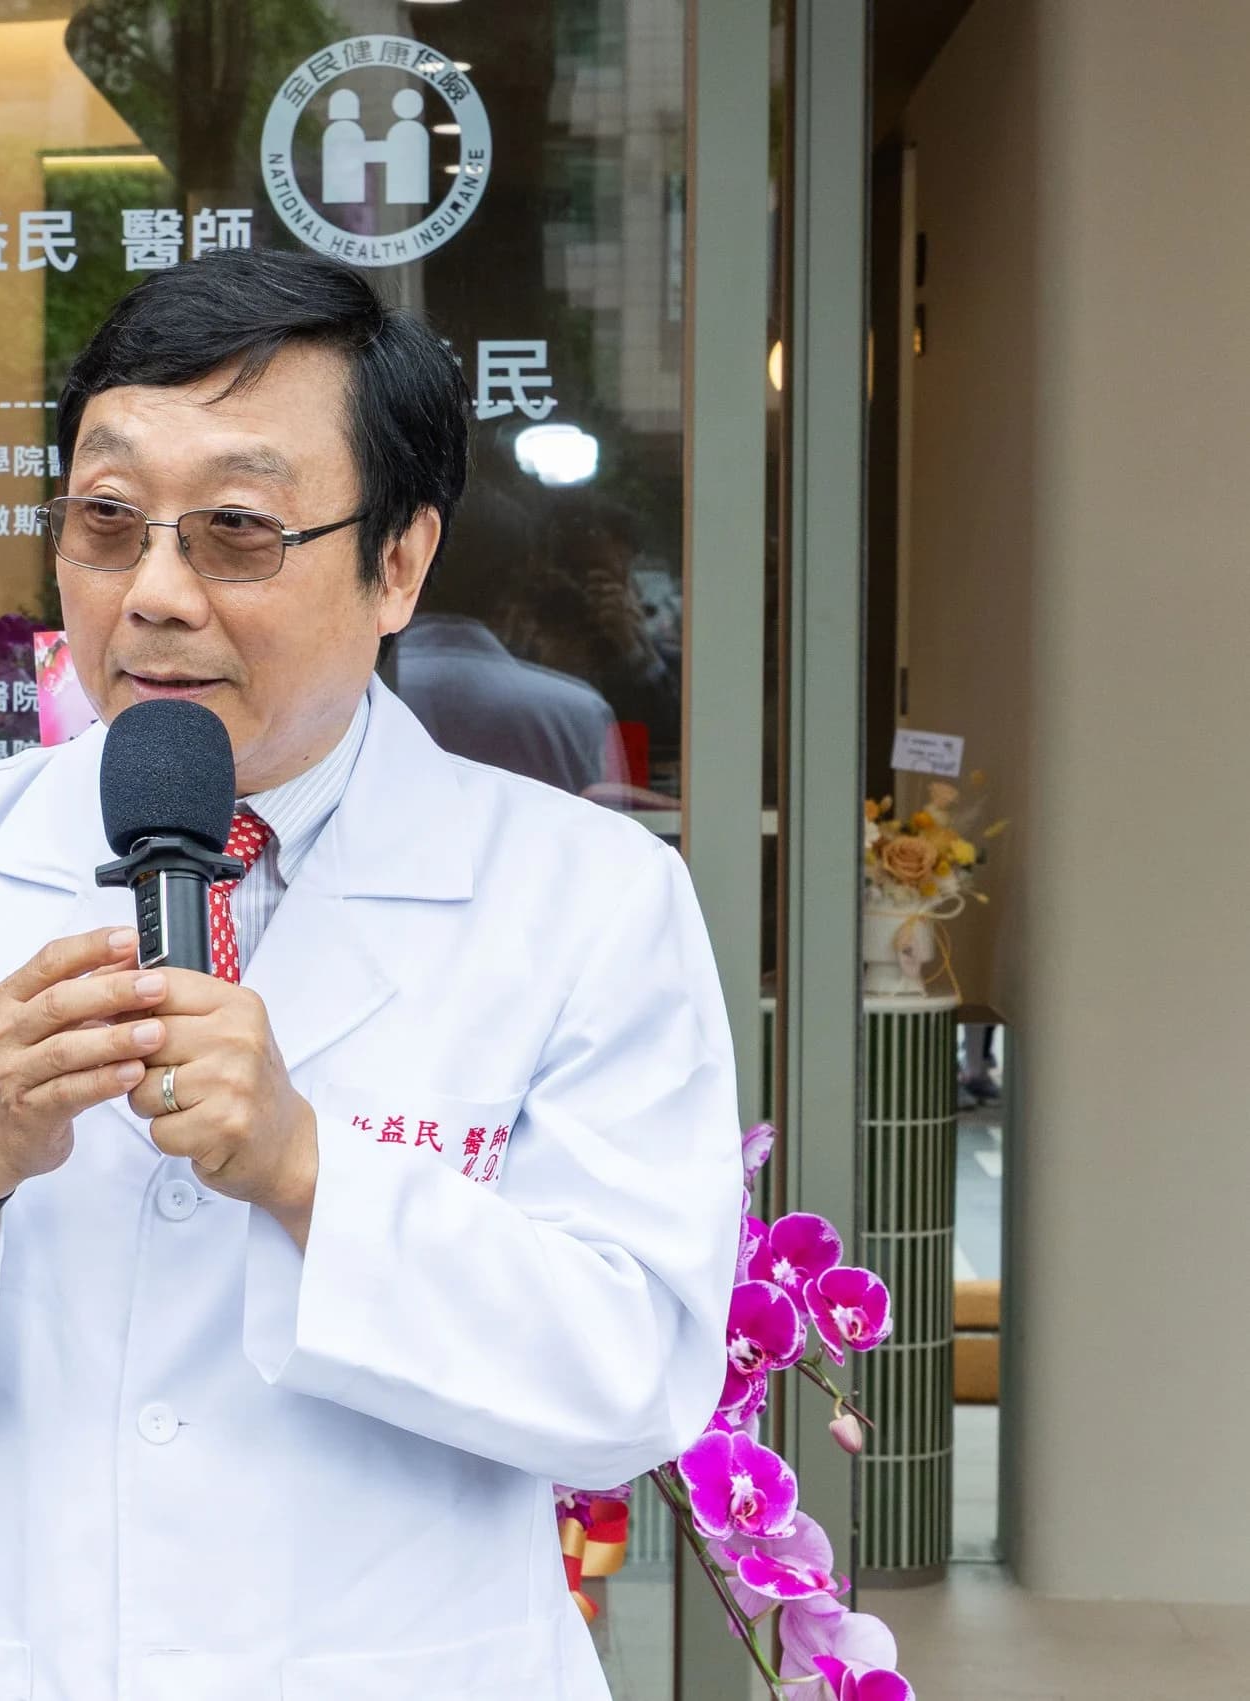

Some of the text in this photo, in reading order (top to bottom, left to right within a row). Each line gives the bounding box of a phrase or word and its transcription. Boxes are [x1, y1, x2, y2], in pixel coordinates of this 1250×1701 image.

[282, 40, 471, 108] 全民健康保險
[269, 148, 485, 260] NATIONAL HEALTH INSURANCE
[121, 208, 253, 271] 醫師
[462, 1124, 509, 1156] 醫師
